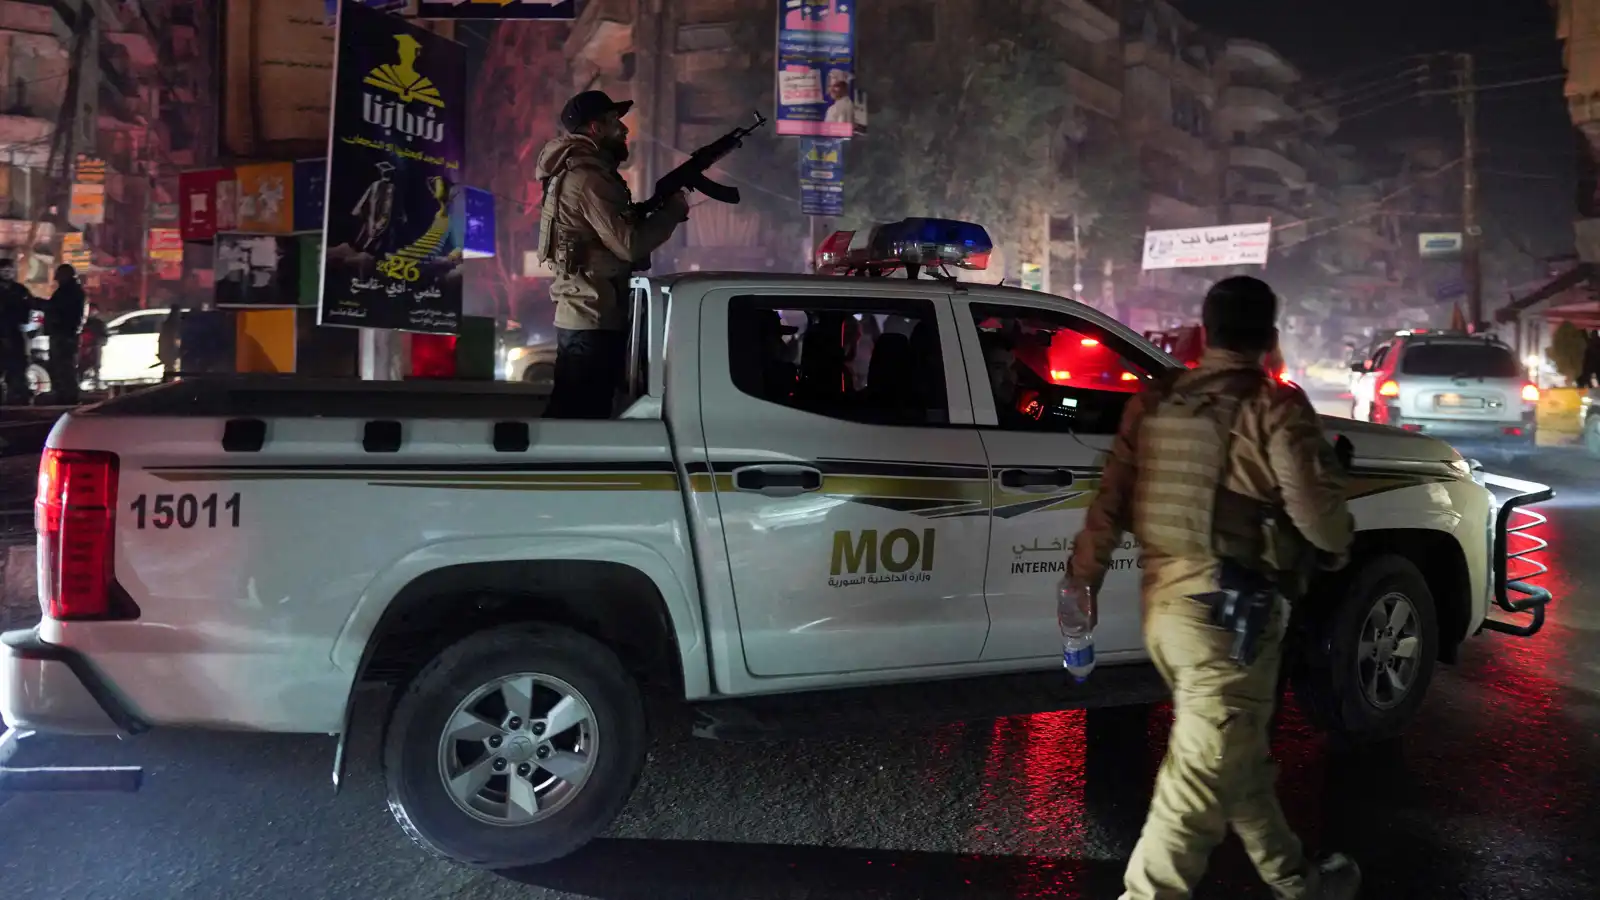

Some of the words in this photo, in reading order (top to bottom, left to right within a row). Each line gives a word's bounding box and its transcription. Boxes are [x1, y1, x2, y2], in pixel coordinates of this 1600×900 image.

[130, 492, 242, 529] 15011
[830, 527, 936, 576] MOI
[1011, 561, 1066, 574] INTERNA
[1107, 558, 1135, 571] RITY
[828, 576, 866, 588] السورية
[867, 574, 908, 585] الداخلية
[909, 572, 932, 584] وزارة
